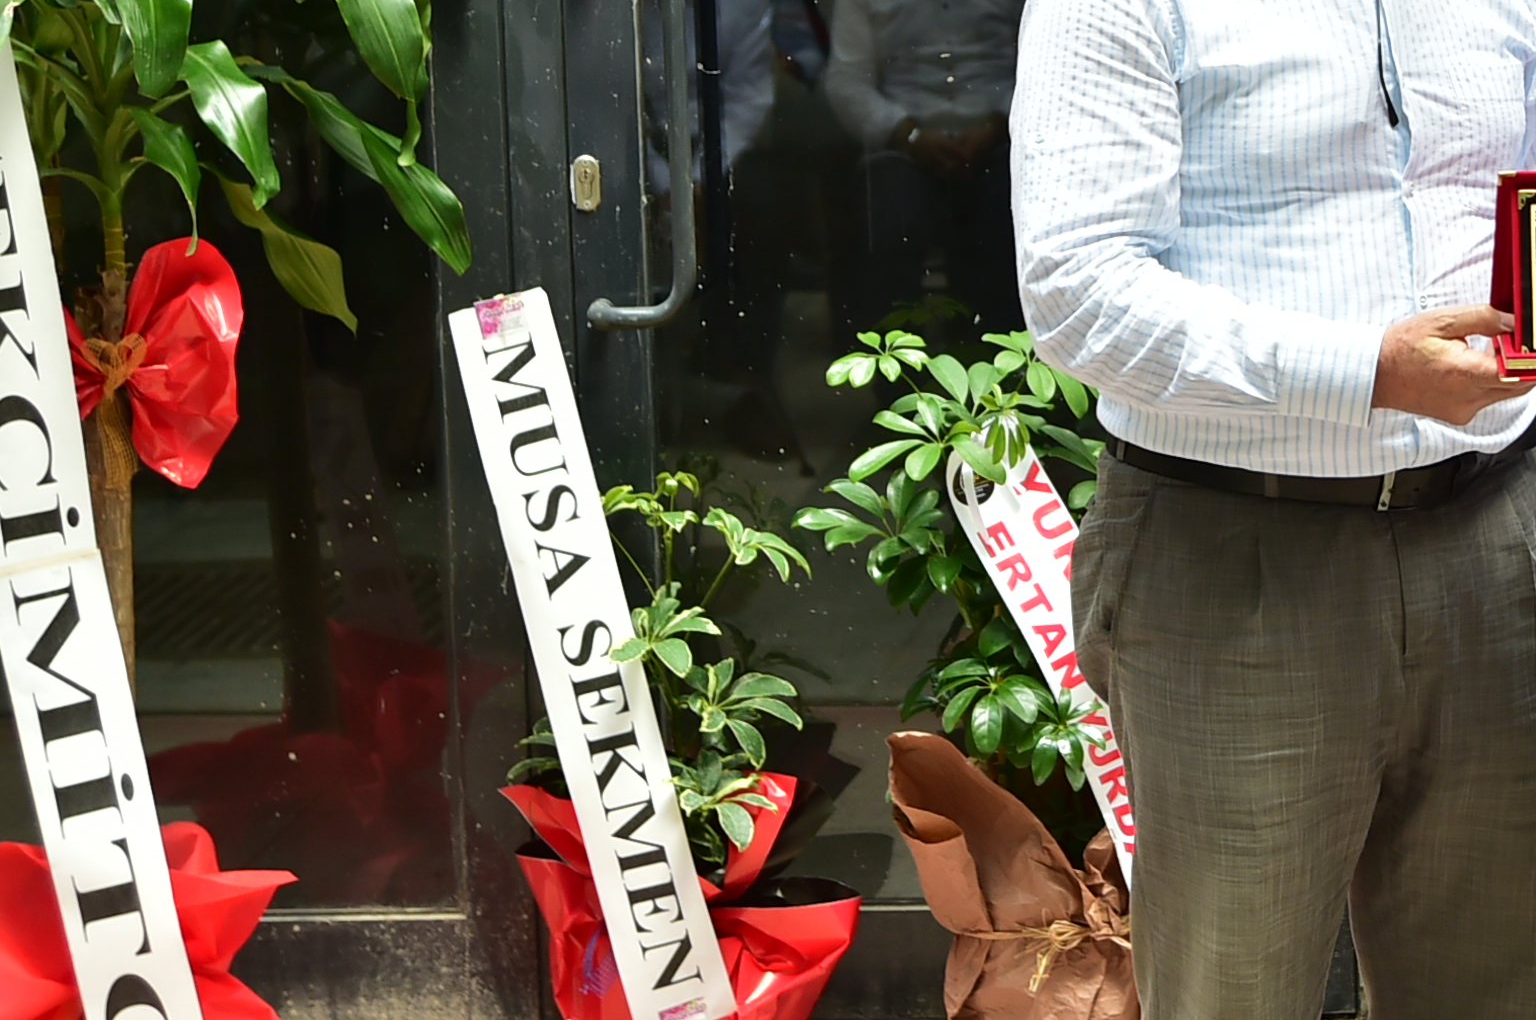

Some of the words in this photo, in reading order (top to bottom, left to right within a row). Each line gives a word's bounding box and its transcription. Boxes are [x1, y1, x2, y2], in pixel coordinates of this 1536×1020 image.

[482, 331, 592, 601] MUSA
[556, 618, 705, 991] SEKMEN
[978, 520, 1087, 690] ERTAN
